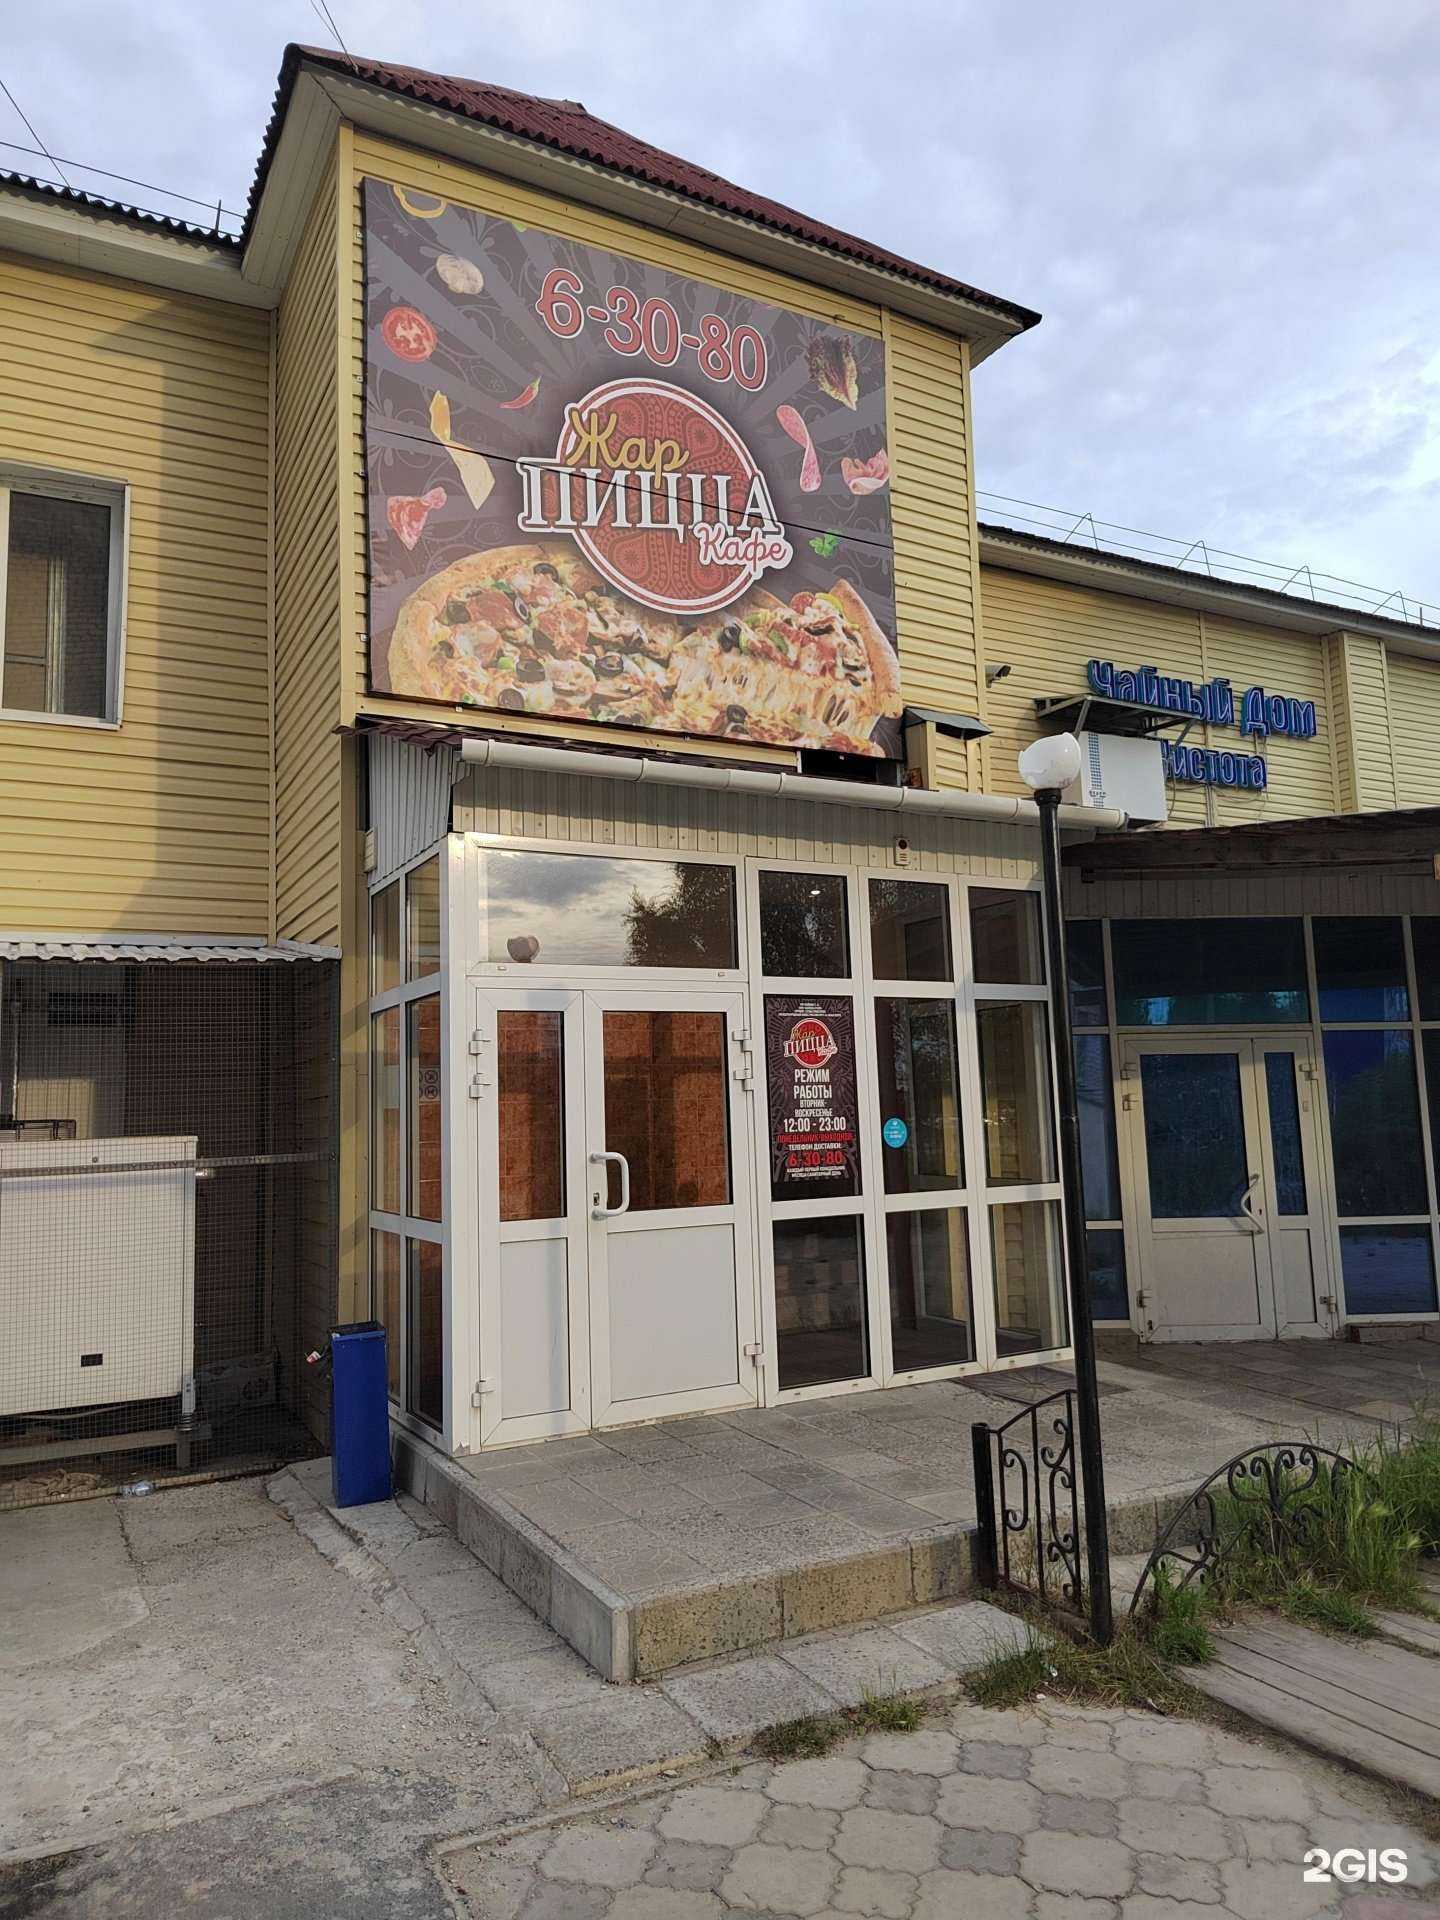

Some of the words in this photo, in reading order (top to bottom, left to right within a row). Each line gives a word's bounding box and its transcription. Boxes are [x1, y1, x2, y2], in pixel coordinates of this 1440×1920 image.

[536, 268, 768, 391] 6-30-80
[566, 407, 690, 489] Жар
[518, 462, 783, 544] ПИЦЦА
[695, 524, 791, 575] Кафе
[1087, 659, 1235, 726] Чайный
[1240, 687, 1318, 738] Дом
[784, 1034, 835, 1057] ПИЦЦА
[793, 1084, 833, 1099] РАБОТЫ
[794, 1068, 830, 1083] РЕЖИМ
[783, 1118, 811, 1133] 12:00
[818, 1116, 847, 1132] 23:00
[794, 1108, 833, 1118] ВОСКРЕСЕНЬЕ
